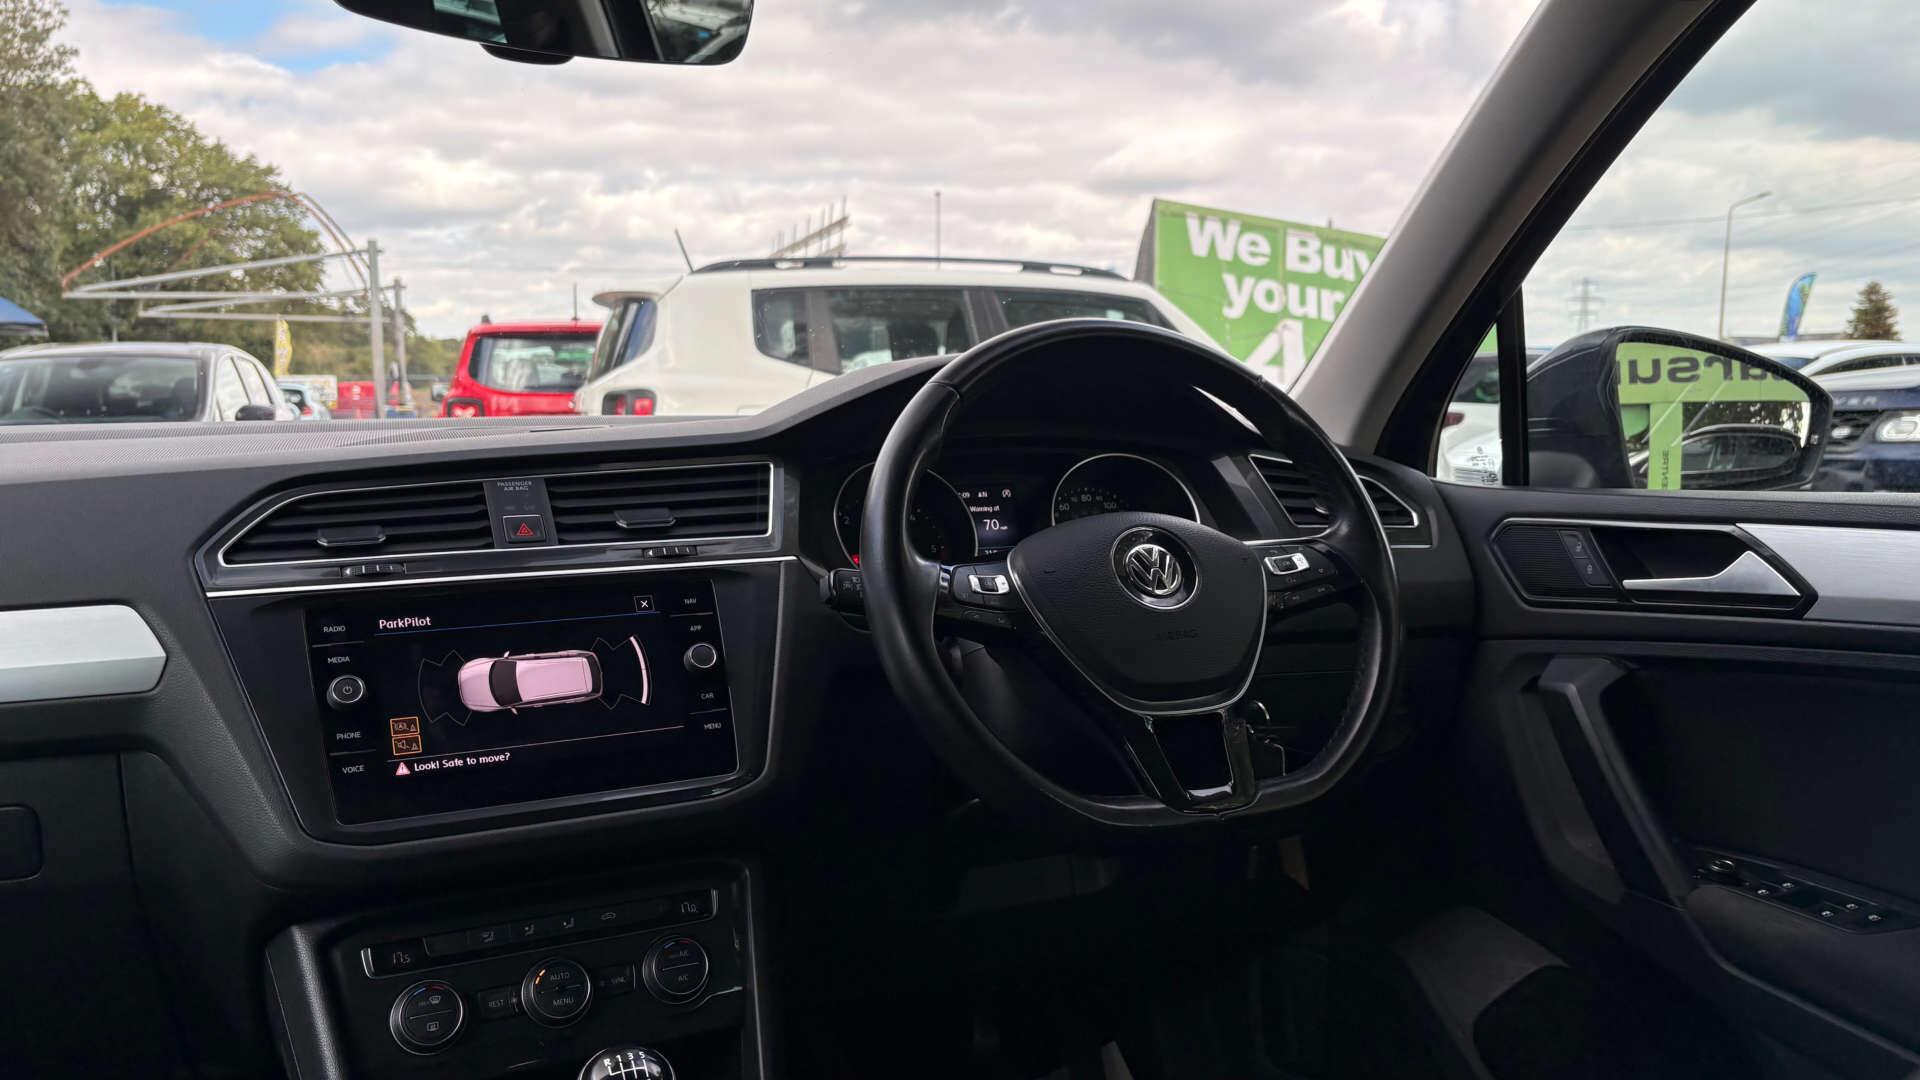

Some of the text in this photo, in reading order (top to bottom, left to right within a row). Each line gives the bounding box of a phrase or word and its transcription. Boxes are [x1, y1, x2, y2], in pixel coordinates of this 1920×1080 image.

[1185, 211, 1272, 267] We
[1222, 272, 1346, 322] your
[969, 505, 993, 513] Warning
[983, 518, 1000, 531] 70
[379, 616, 432, 630] ParkPilot
[323, 625, 346, 633] RADIO
[327, 656, 351, 664] MEDIA
[700, 692, 714, 700] CAR
[704, 722, 722, 731] MENU
[336, 731, 361, 740] PHONE
[414, 752, 511, 772] Look! Safe to move?
[342, 765, 365, 774] VOICE
[550, 971, 571, 981] AUTO
[552, 997, 575, 1007] MENU
[603, 1051, 646, 1067] R 1 3 5
